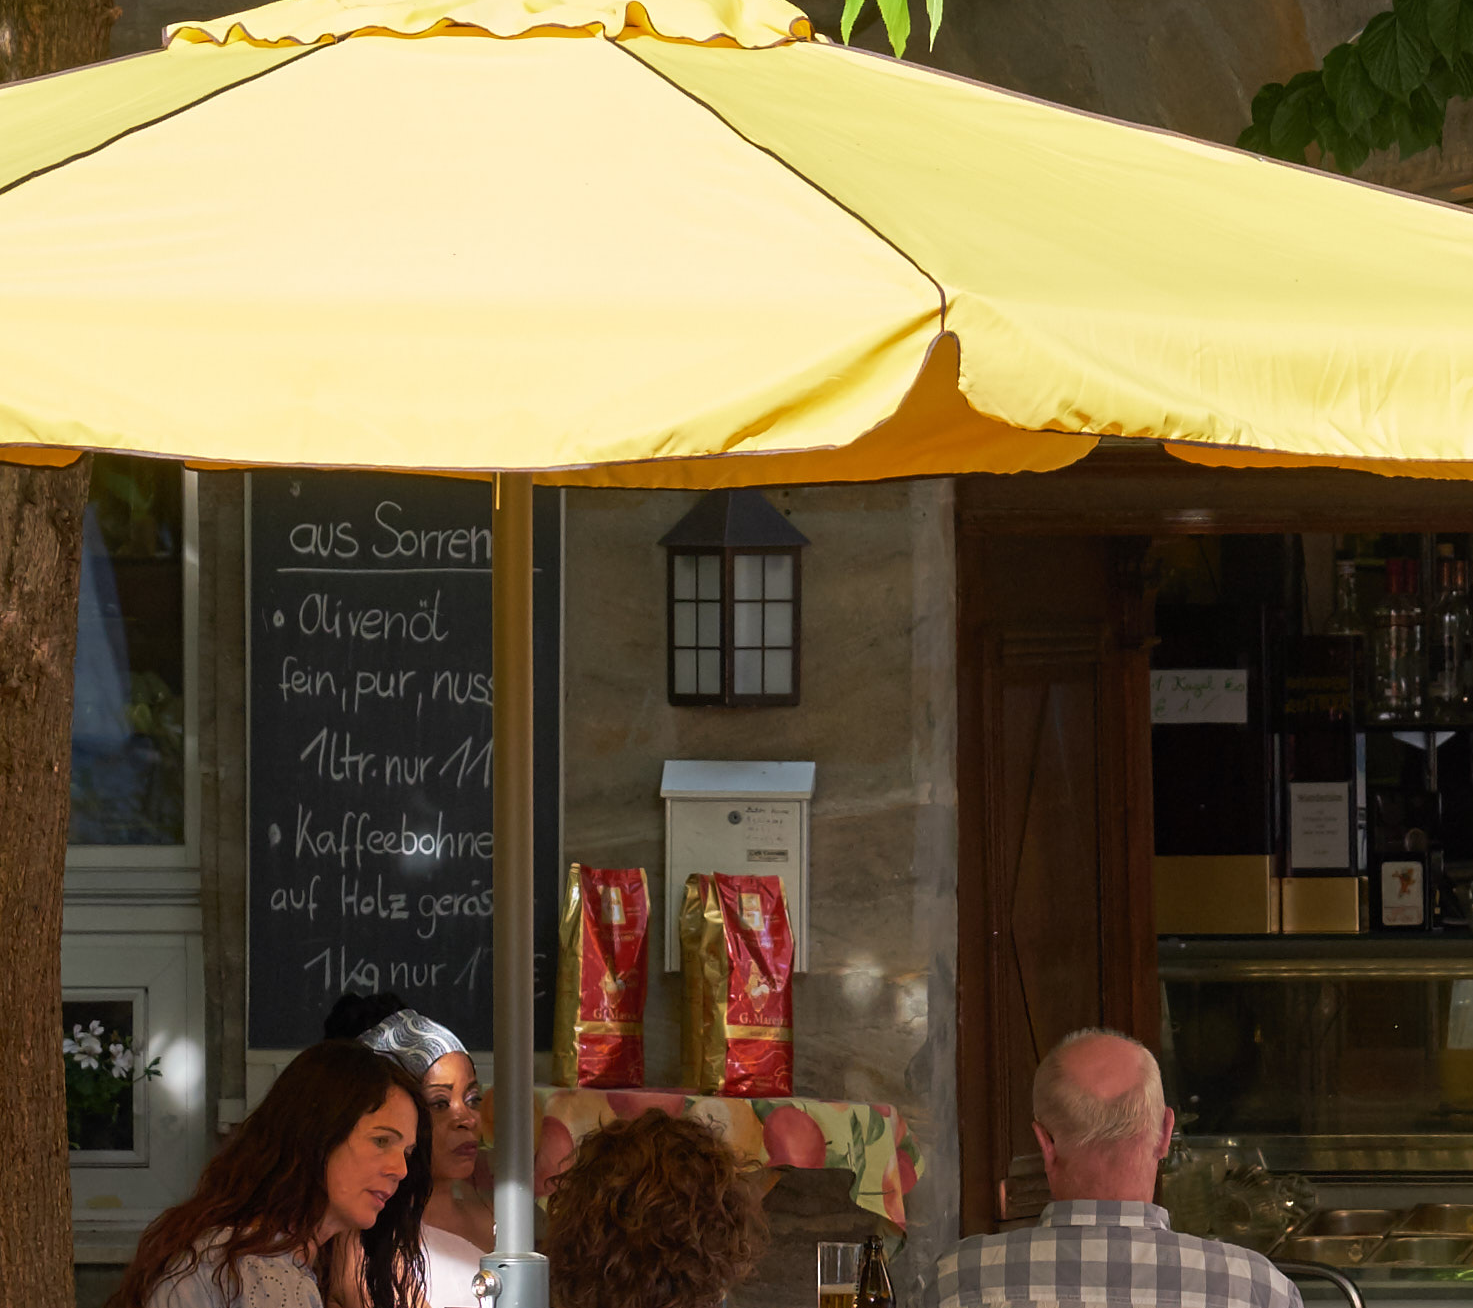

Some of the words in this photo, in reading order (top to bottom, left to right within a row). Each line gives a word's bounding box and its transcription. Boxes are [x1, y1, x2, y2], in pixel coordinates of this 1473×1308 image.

[288, 521, 360, 559] aus
[370, 500, 492, 565] Sorren
[298, 589, 450, 642] Olivenöl
[385, 751, 436, 787] nur
[294, 803, 494, 871] Kaffeebohne
[270, 875, 322, 922] auf
[340, 878, 410, 921] Holz
[389, 959, 448, 991] nur
